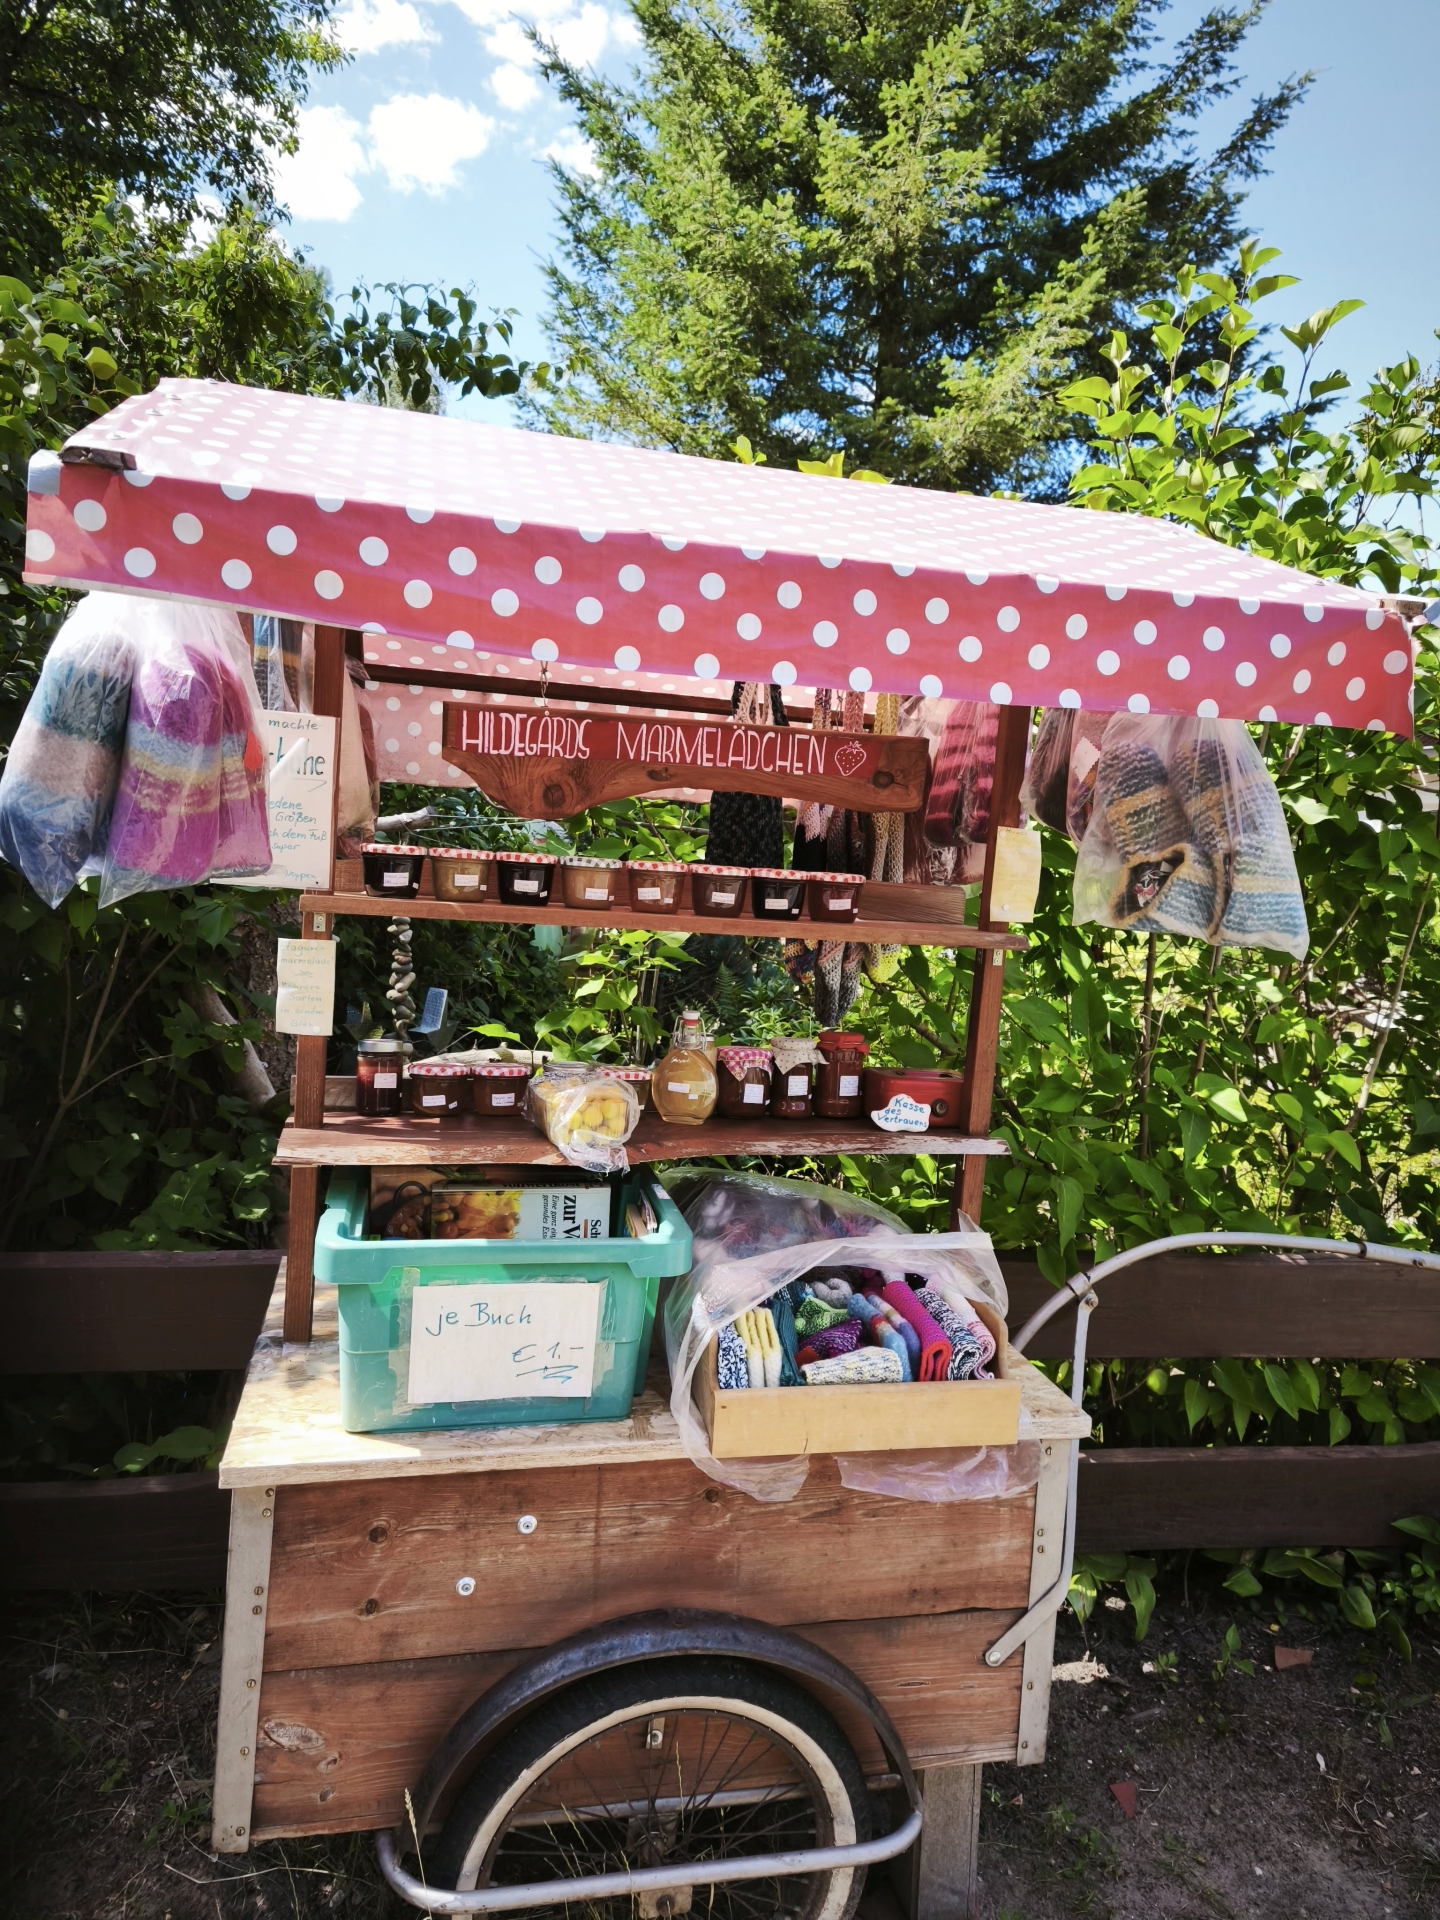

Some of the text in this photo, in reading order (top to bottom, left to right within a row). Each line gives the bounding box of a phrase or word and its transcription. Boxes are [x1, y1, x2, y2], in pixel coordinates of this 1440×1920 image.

[461, 709, 828, 776] HILDEGARDS MARMELÄDCHEN
[275, 811, 317, 827] Größen
[282, 828, 306, 840] dem
[308, 828, 328, 842] Fuß
[884, 1107, 902, 1115] des
[894, 1097, 925, 1114] Kasse
[877, 1112, 928, 1128] Vertrauens
[552, 1195, 560, 1209] Eine
[562, 1195, 577, 1224] zur
[549, 1210, 557, 1226] ganz
[425, 1302, 532, 1337] je Buch
